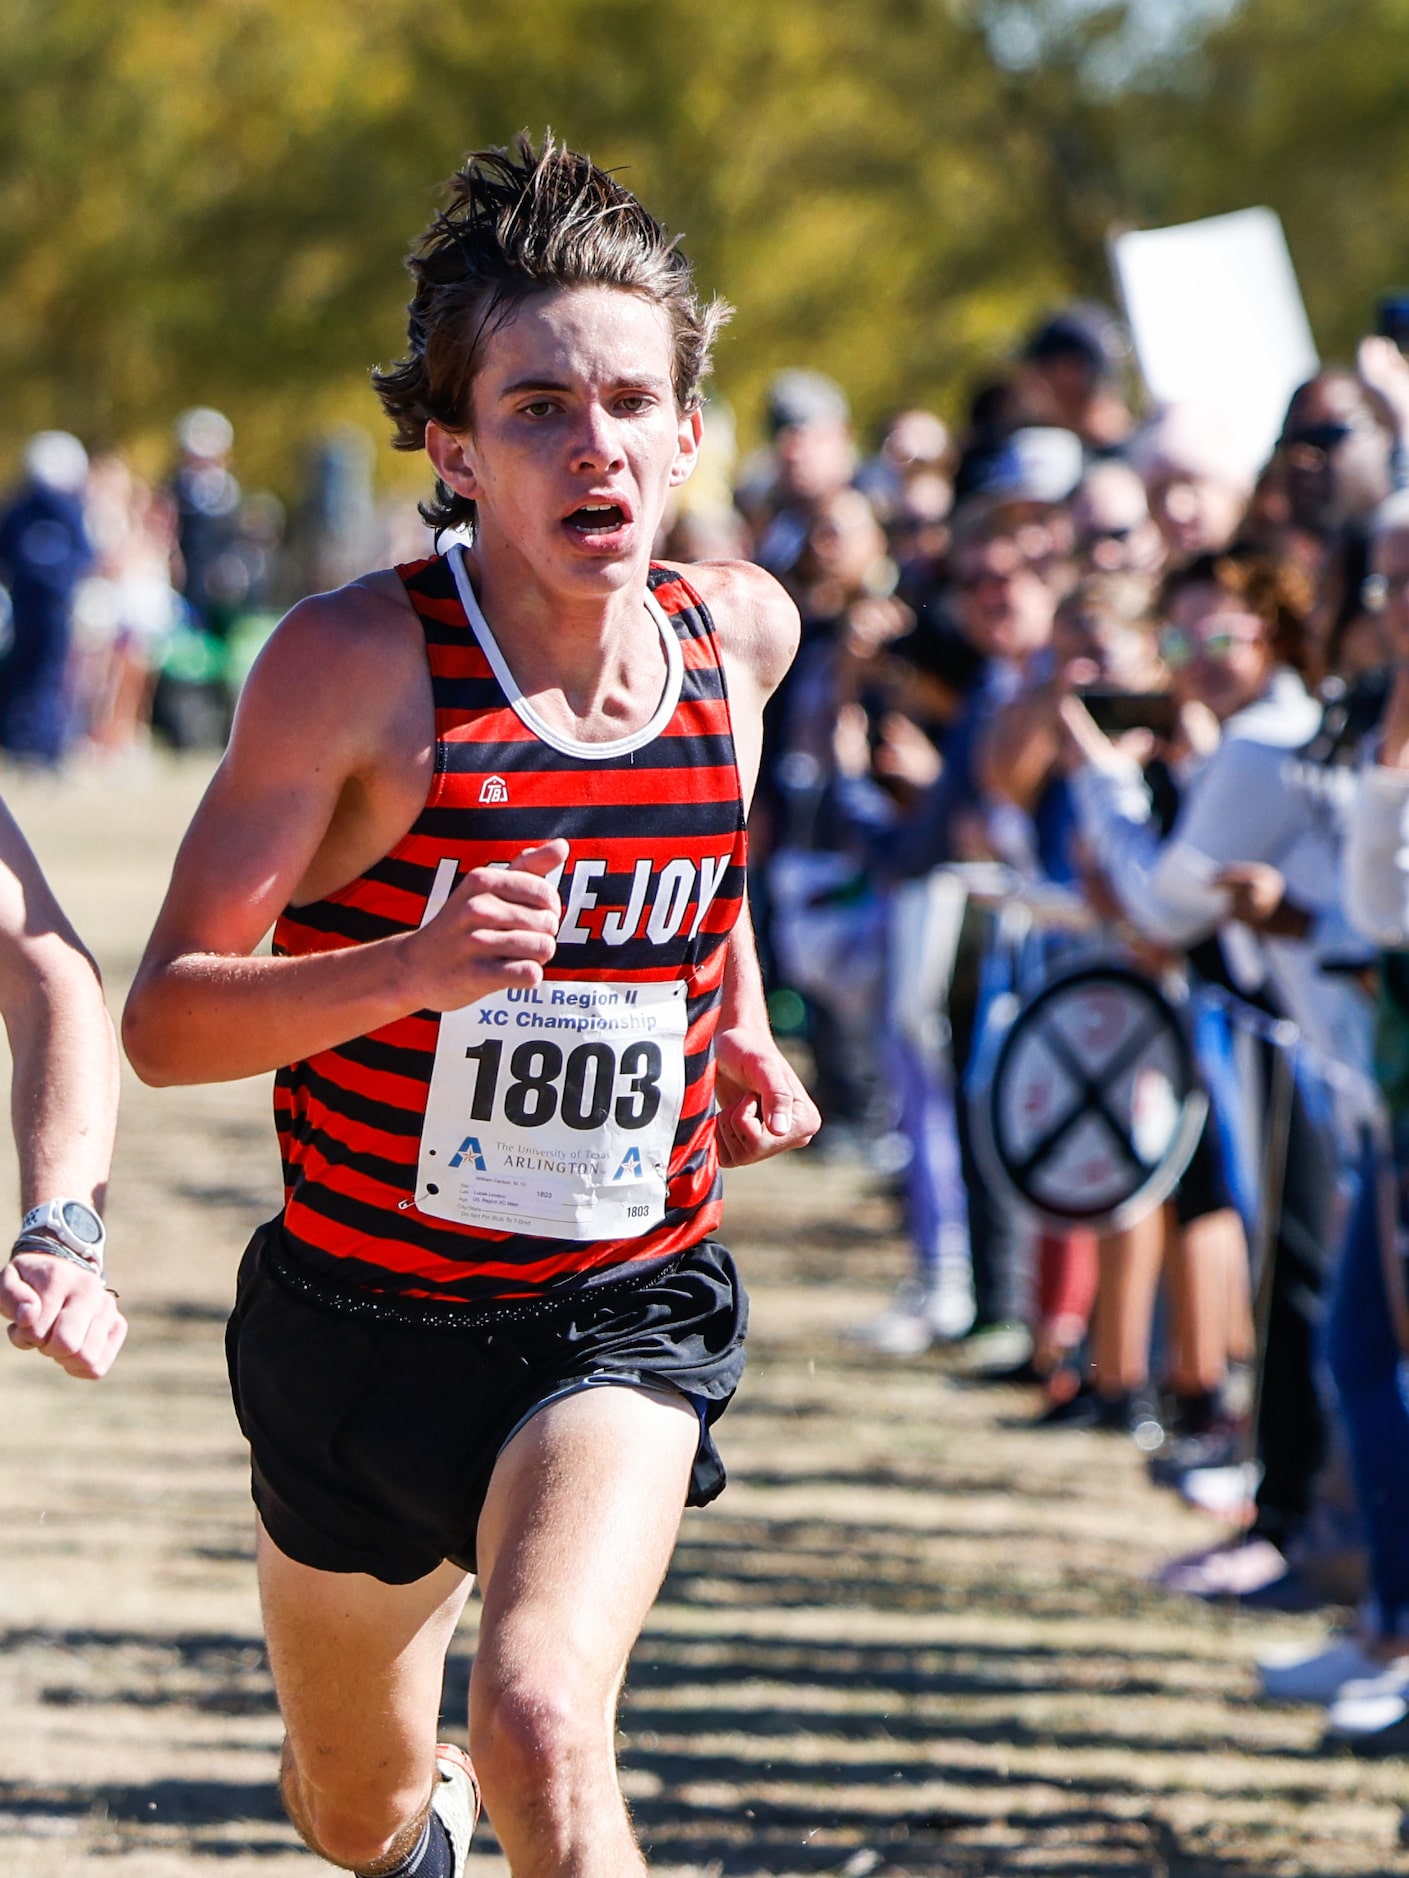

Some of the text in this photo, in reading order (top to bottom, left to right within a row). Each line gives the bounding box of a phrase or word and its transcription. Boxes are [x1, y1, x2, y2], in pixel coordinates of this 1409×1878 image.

[419, 852, 732, 945] LEJOY
[506, 987, 543, 1004] UIL
[551, 989, 618, 1008] Region
[478, 1009, 657, 1033] XC Championship
[465, 1038, 662, 1131] 1803
[495, 1141, 610, 1160] The University of Texas
[503, 1155, 600, 1174] ARLINGTON
[536, 1191, 552, 1199] 1803
[626, 1205, 650, 1219] 1803
